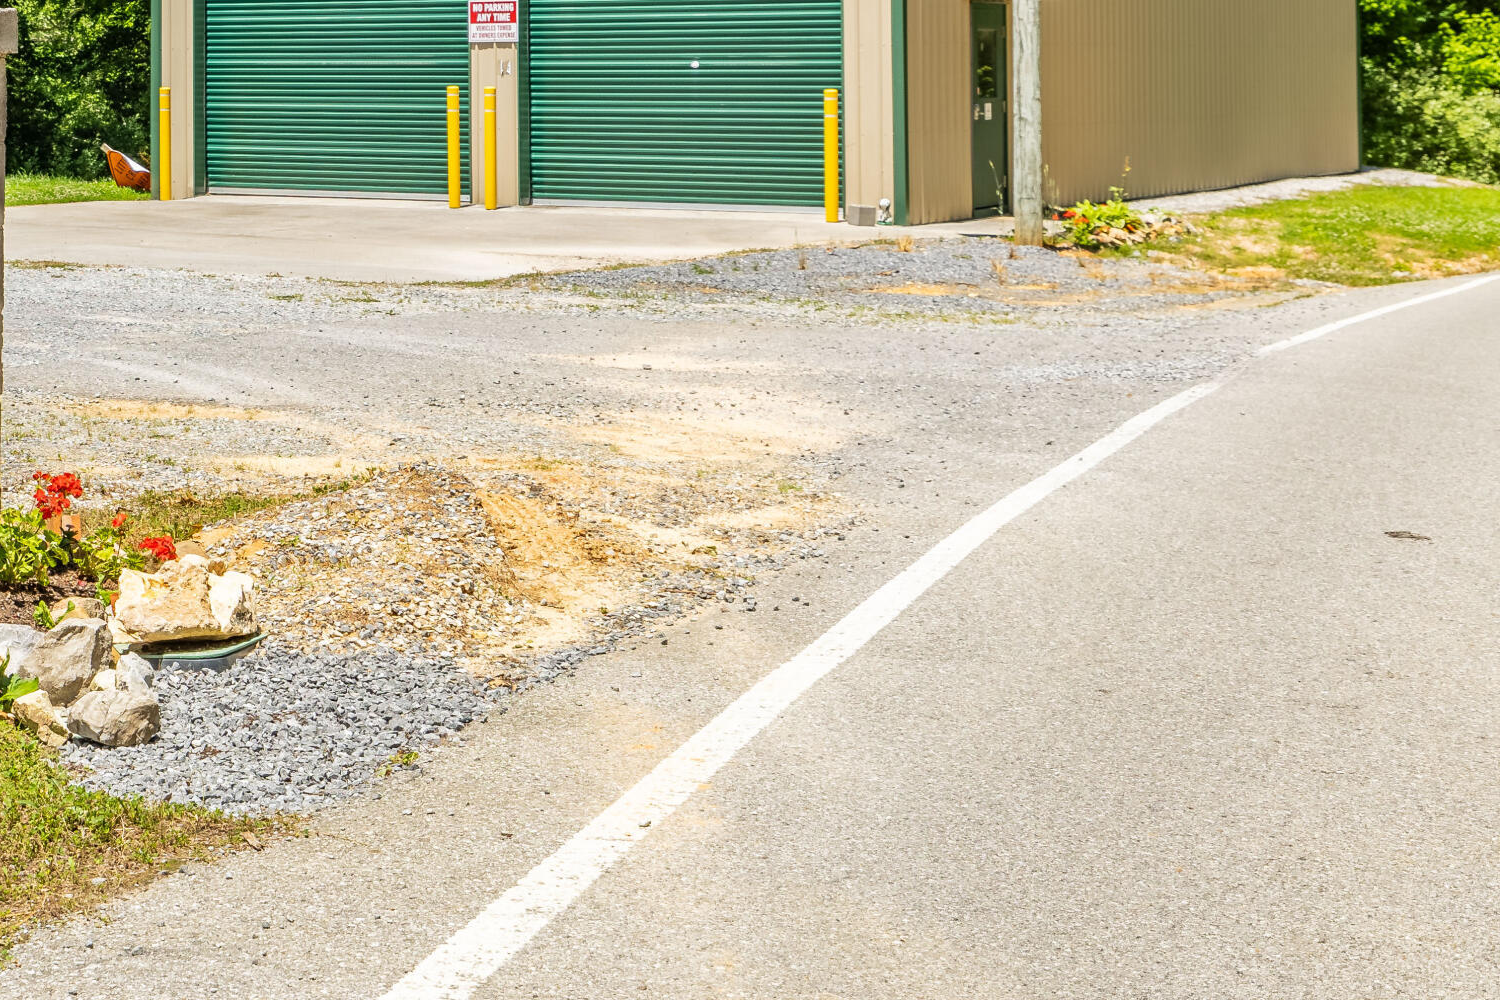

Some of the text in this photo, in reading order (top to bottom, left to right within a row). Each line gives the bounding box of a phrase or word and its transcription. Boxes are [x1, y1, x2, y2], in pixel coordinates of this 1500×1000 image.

[472, 3, 514, 13] NO PARKING
[477, 13, 511, 22] ANY TIME
